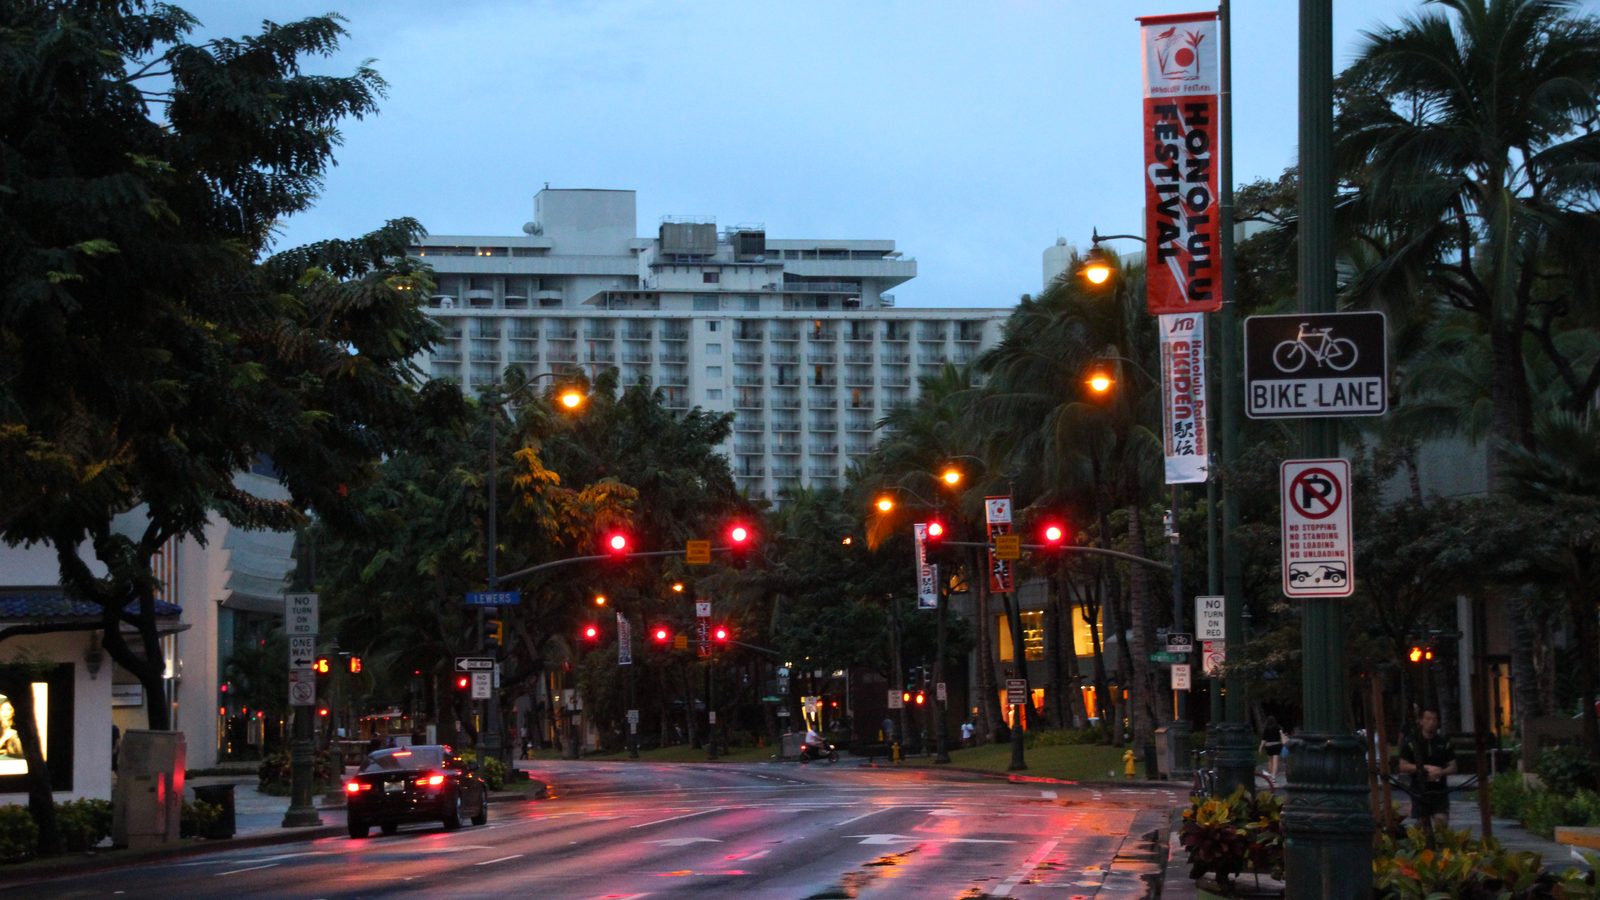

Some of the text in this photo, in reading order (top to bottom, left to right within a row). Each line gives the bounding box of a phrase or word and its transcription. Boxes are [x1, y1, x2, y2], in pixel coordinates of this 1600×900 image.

[1153, 104, 1181, 264] FESTIVAL
[1184, 103, 1213, 300] HONOLULU
[1170, 317, 1195, 333] JTB
[1191, 340, 1203, 395] Honolulu
[1253, 382, 1379, 408] BIKE LANE
[1302, 523, 1337, 531] STOPPING
[1302, 532, 1339, 540] STANDING
[1303, 541, 1335, 549] LOADING
[1303, 550, 1345, 558] UNLOADING
[294, 597, 310, 605] NO
[474, 593, 512, 604] LEWERS
[1205, 600, 1221, 608] NO
[292, 639, 312, 647] ONE
[292, 648, 312, 656] WAY
